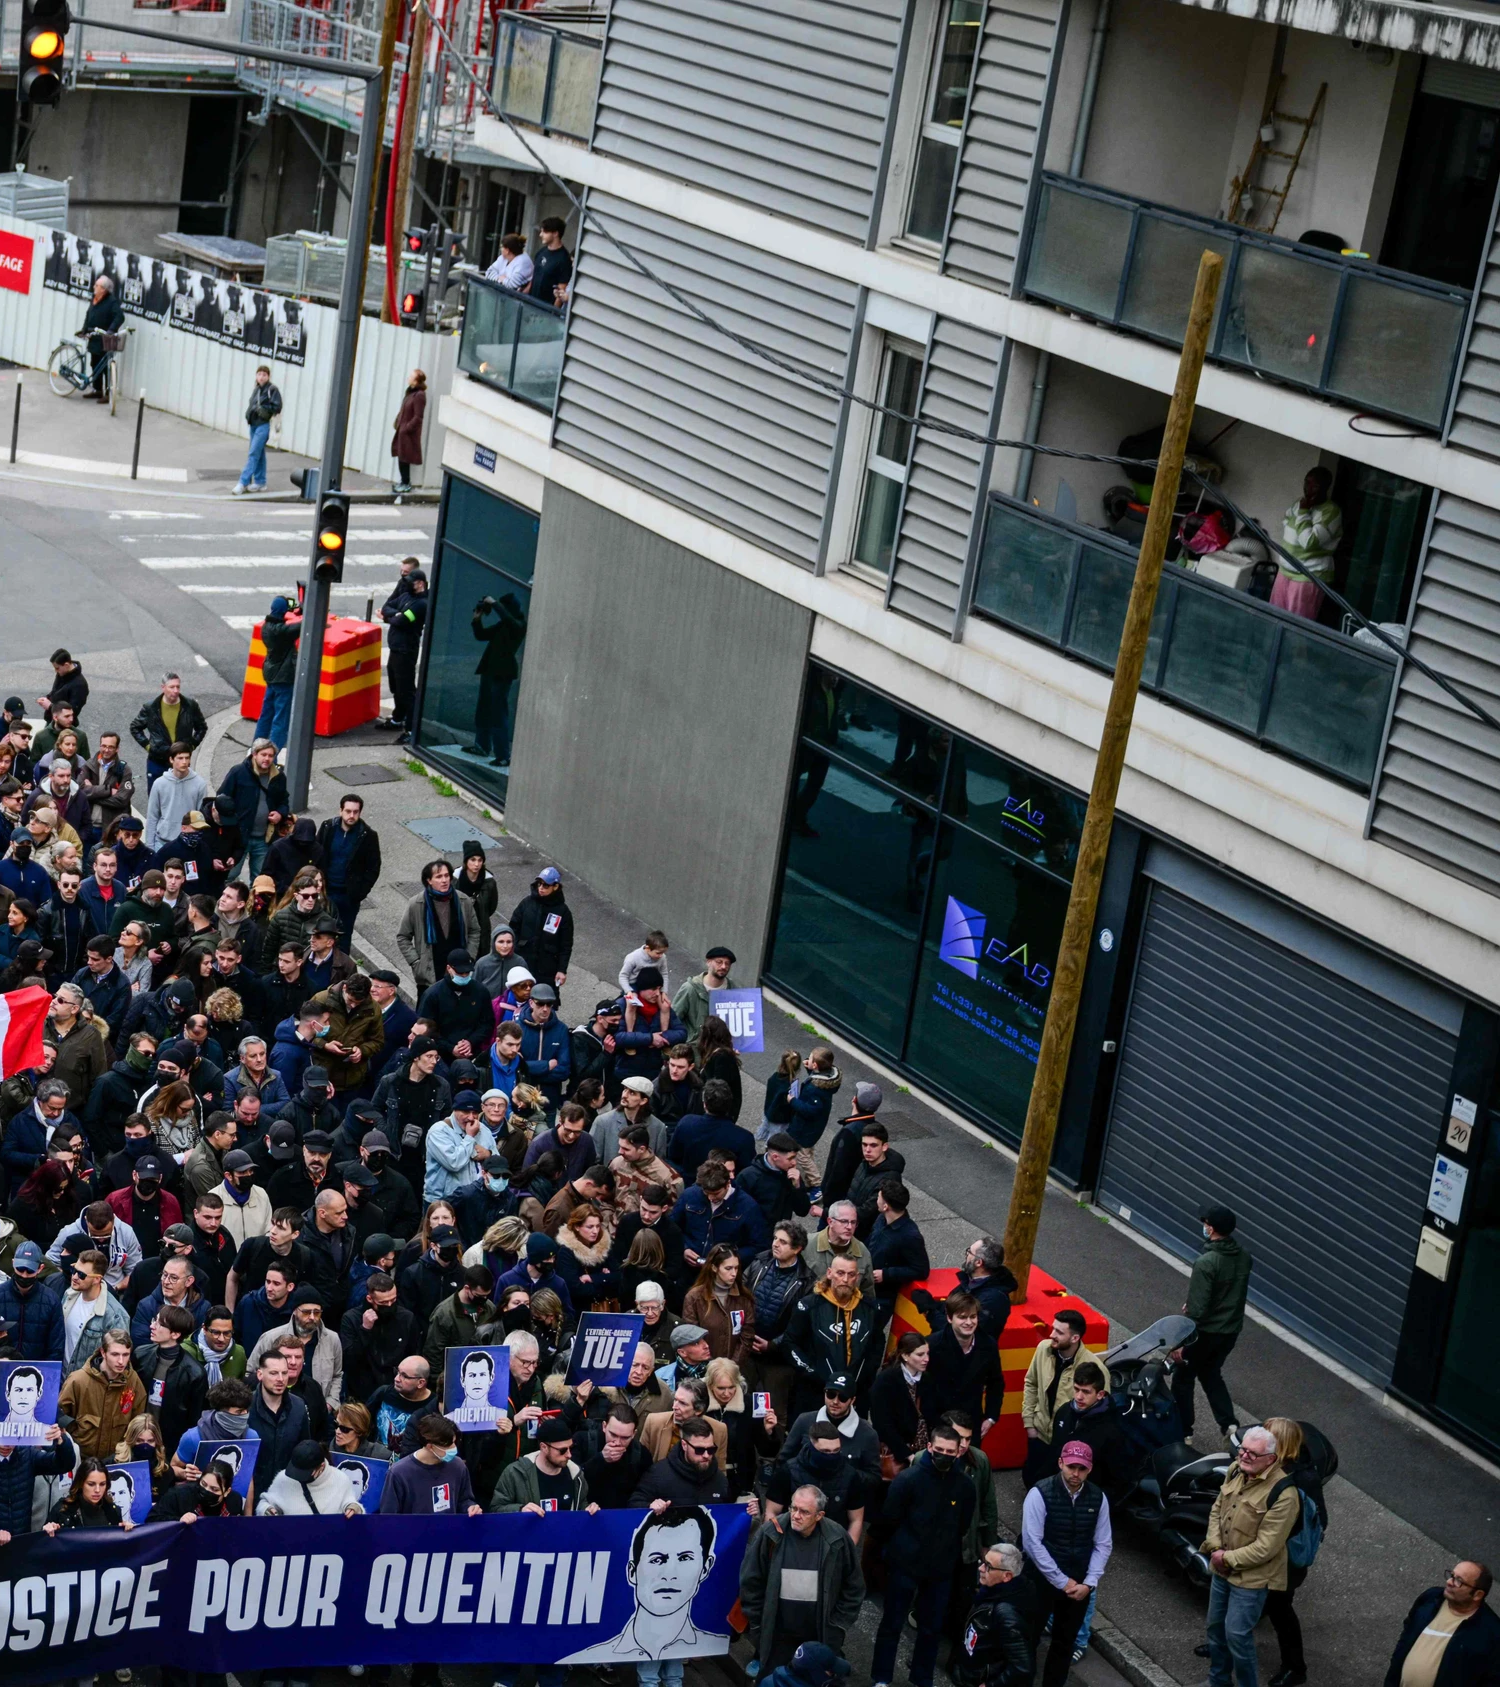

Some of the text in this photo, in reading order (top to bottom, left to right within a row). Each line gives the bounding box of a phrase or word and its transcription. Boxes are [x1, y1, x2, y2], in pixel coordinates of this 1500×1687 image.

[1004, 796, 1045, 826] EAB
[985, 937, 1050, 987] EAB
[716, 1007, 755, 1037] TUE
[975, 1007, 988, 1020] 04
[990, 1016, 1002, 1028] 37
[1006, 1024, 1018, 1038] 28
[1021, 1034, 1040, 1052] 300
[1450, 1125, 1468, 1144] 20
[585, 1328, 633, 1337] L'EXTRÊME-GAUCHE
[581, 1336, 631, 1369] TUE
[454, 1408, 498, 1423] QUENTIN
[188, 1553, 344, 1634] POUR
[364, 1551, 611, 1629] QUENTIN
